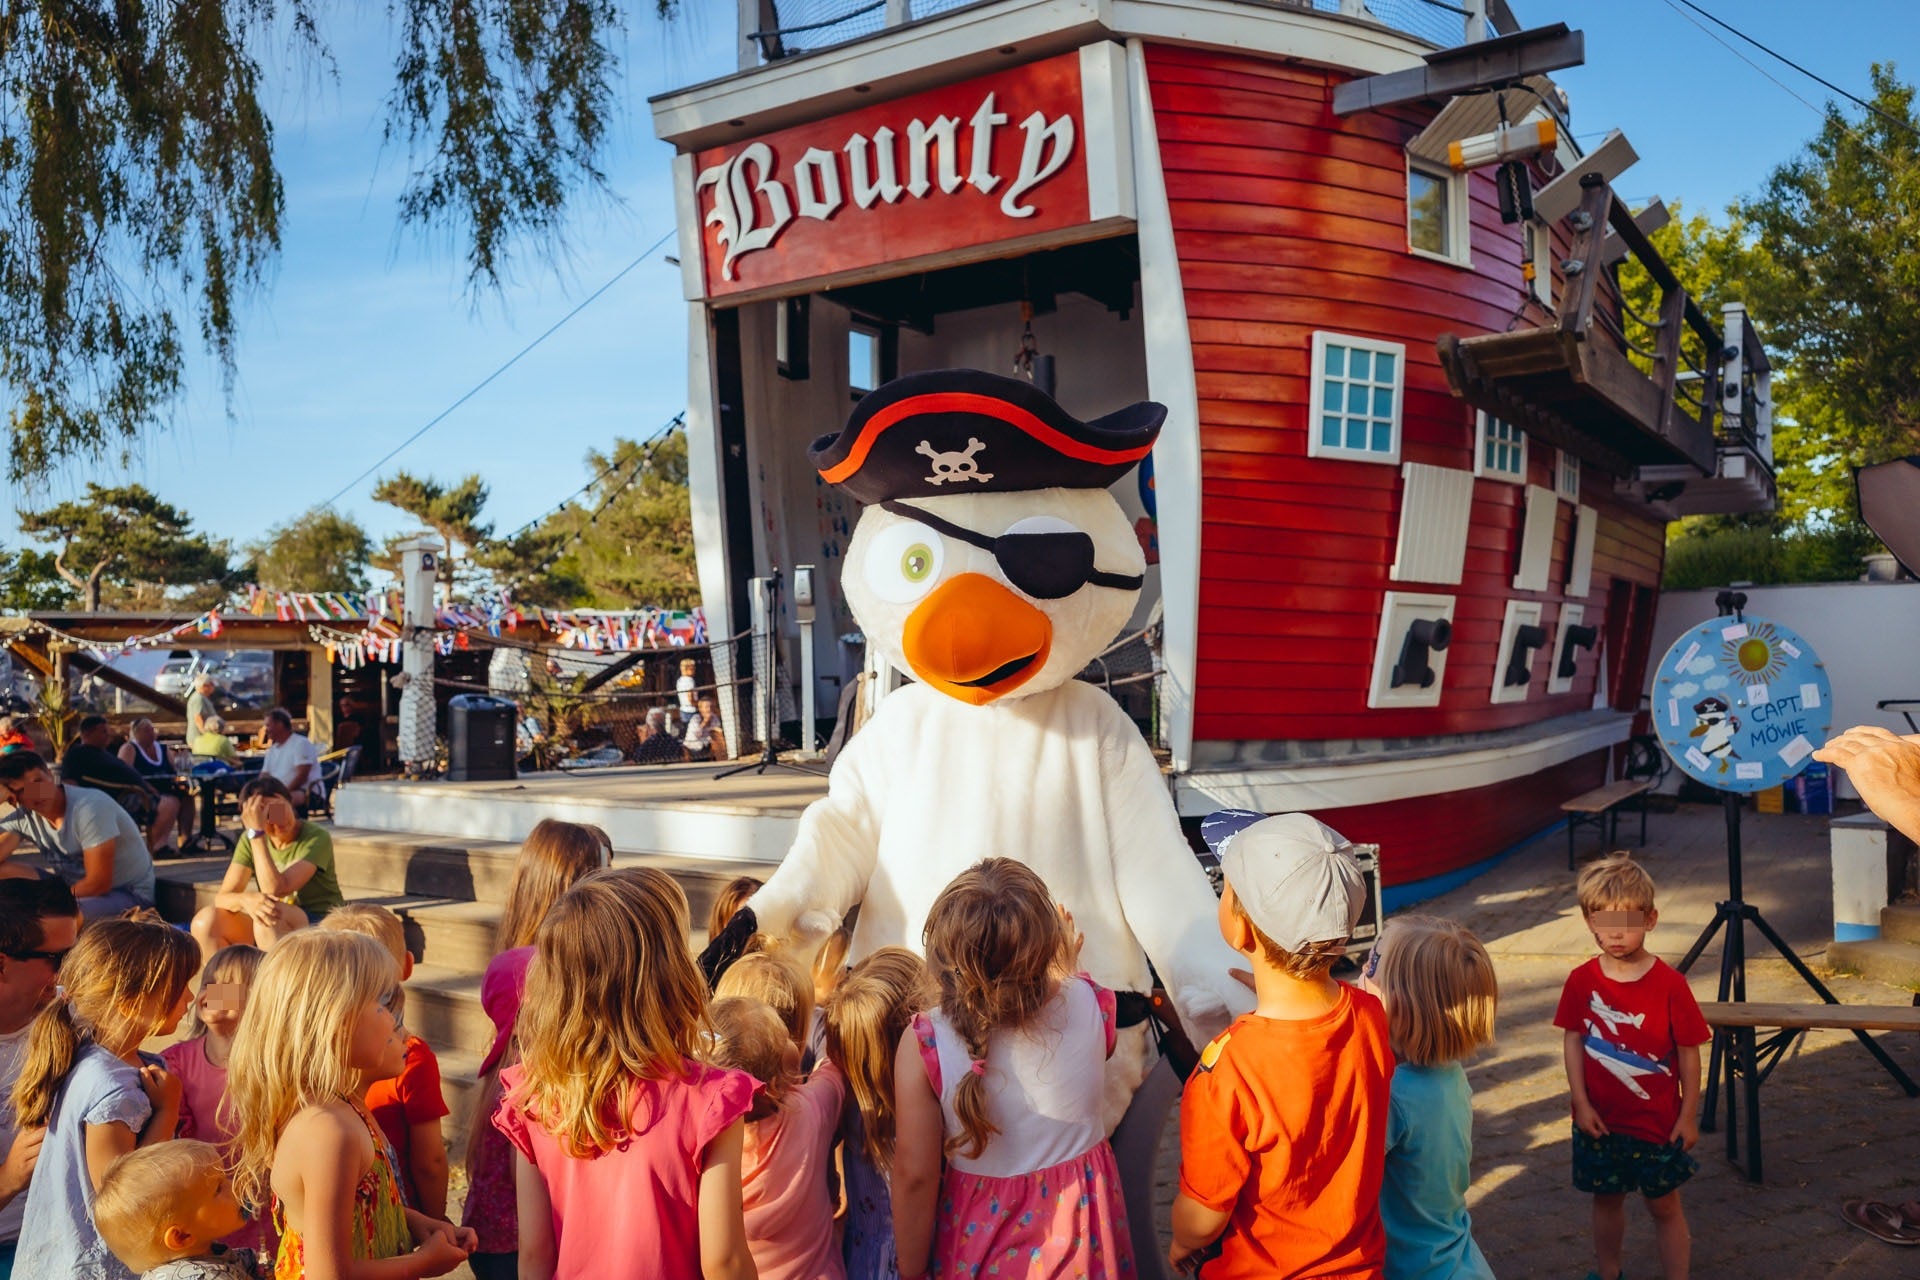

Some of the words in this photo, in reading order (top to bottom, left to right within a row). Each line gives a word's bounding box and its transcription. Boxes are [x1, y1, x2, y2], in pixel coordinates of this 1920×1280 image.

[696, 91, 1075, 281] Bounty
[1751, 695, 1803, 722] CAPT.
[1750, 718, 1808, 748] MÖWIE
